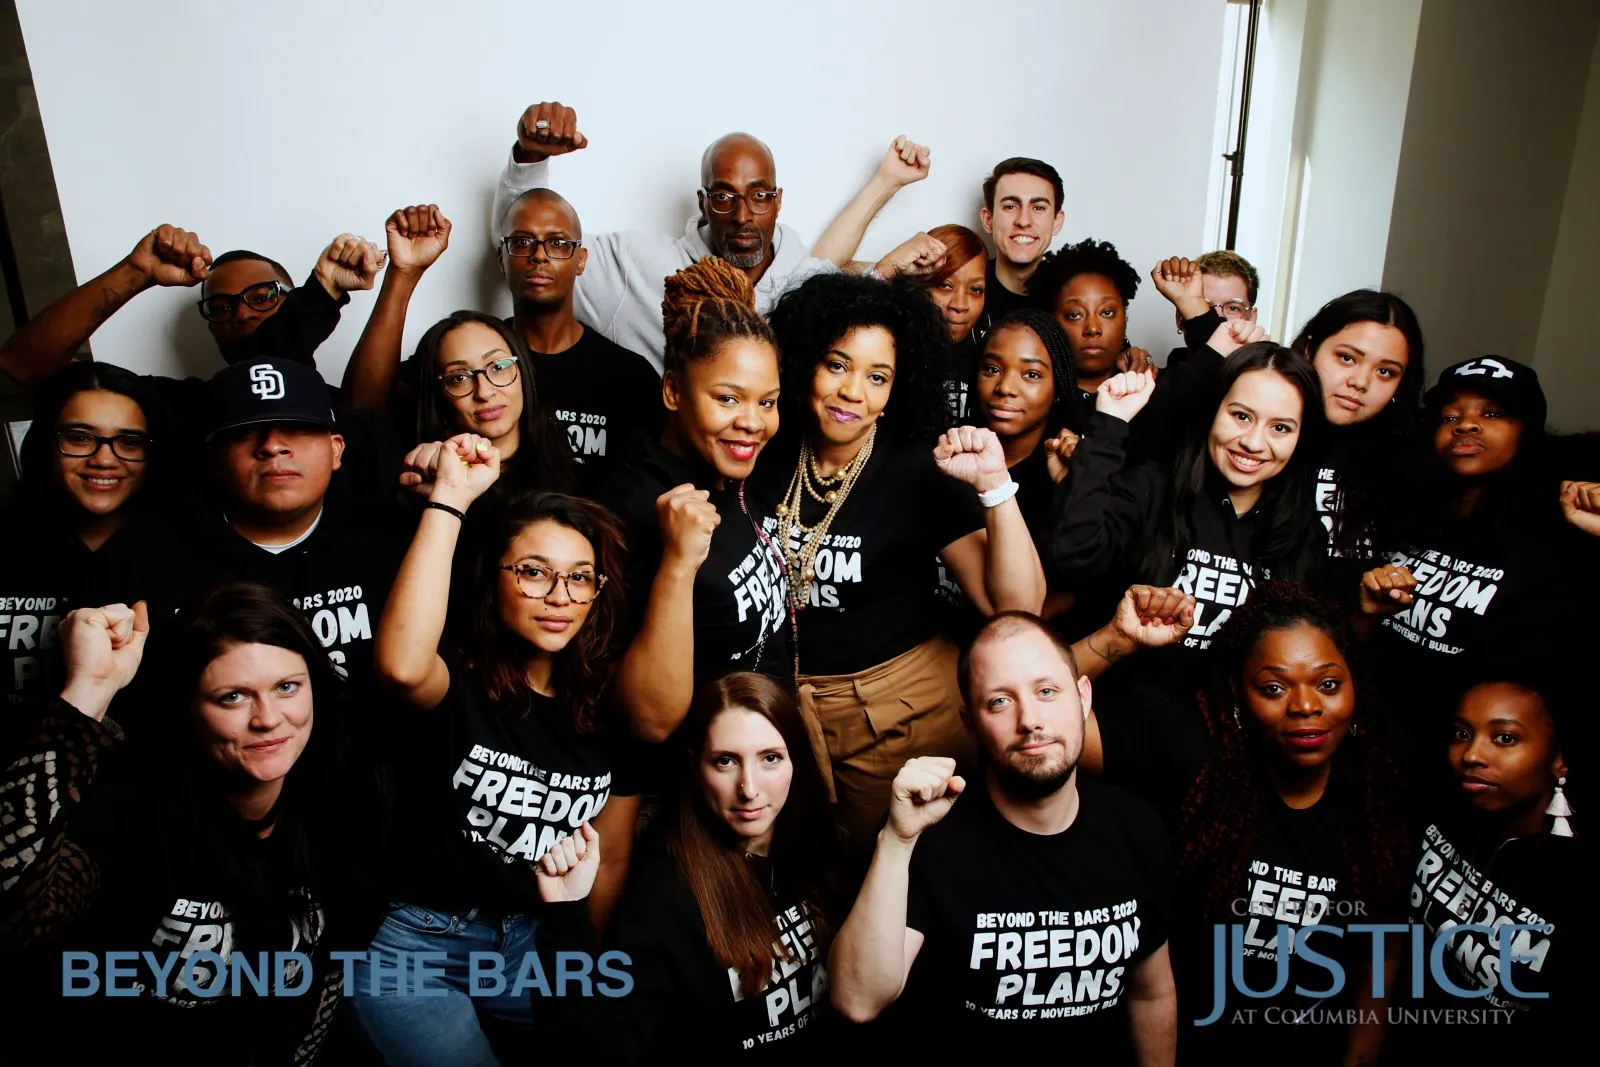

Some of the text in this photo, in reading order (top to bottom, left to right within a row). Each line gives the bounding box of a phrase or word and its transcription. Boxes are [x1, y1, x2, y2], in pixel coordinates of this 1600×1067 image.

[580, 413, 607, 426] 2020
[832, 535, 862, 549] 2020
[1213, 555, 1239, 572] THE
[1472, 566, 1505, 581] 2020
[327, 585, 363, 605] 2020
[1184, 638, 1198, 649] OF
[469, 744, 525, 772] BEYOND
[549, 772, 591, 791] BARS
[1273, 866, 1303, 887] THE
[1307, 875, 1337, 892] BAR
[1481, 879, 1517, 914] BARS
[976, 898, 1138, 929] BEYOND THE BARS 2020
[969, 915, 1142, 971] FREEDOM
[995, 966, 1126, 1006] PLANS
[1021, 1008, 1037, 1020] OF
[1040, 1002, 1101, 1019] MOVEMENT
[742, 1013, 809, 1050] 10 YEARS OF
